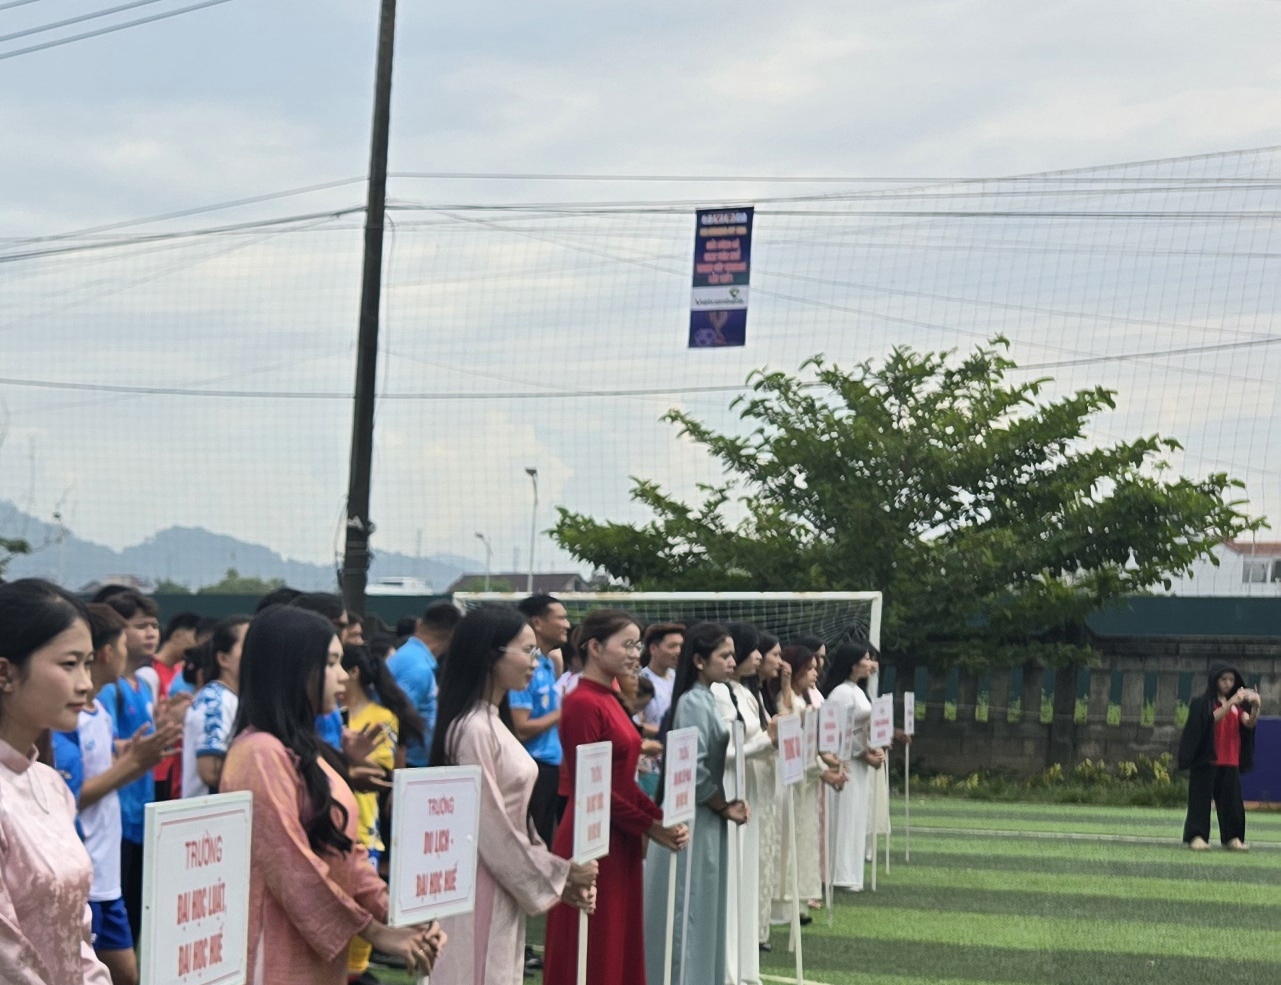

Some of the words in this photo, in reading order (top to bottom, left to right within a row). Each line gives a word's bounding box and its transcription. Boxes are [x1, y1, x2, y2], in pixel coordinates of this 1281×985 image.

[185, 829, 223, 869] TRƯỜNG
[177, 892, 190, 931] ĐẠI
[192, 887, 207, 926] HỌC
[178, 944, 191, 982] ĐẠI
[193, 938, 208, 977] HỌC
[209, 922, 224, 965] HUẾ
